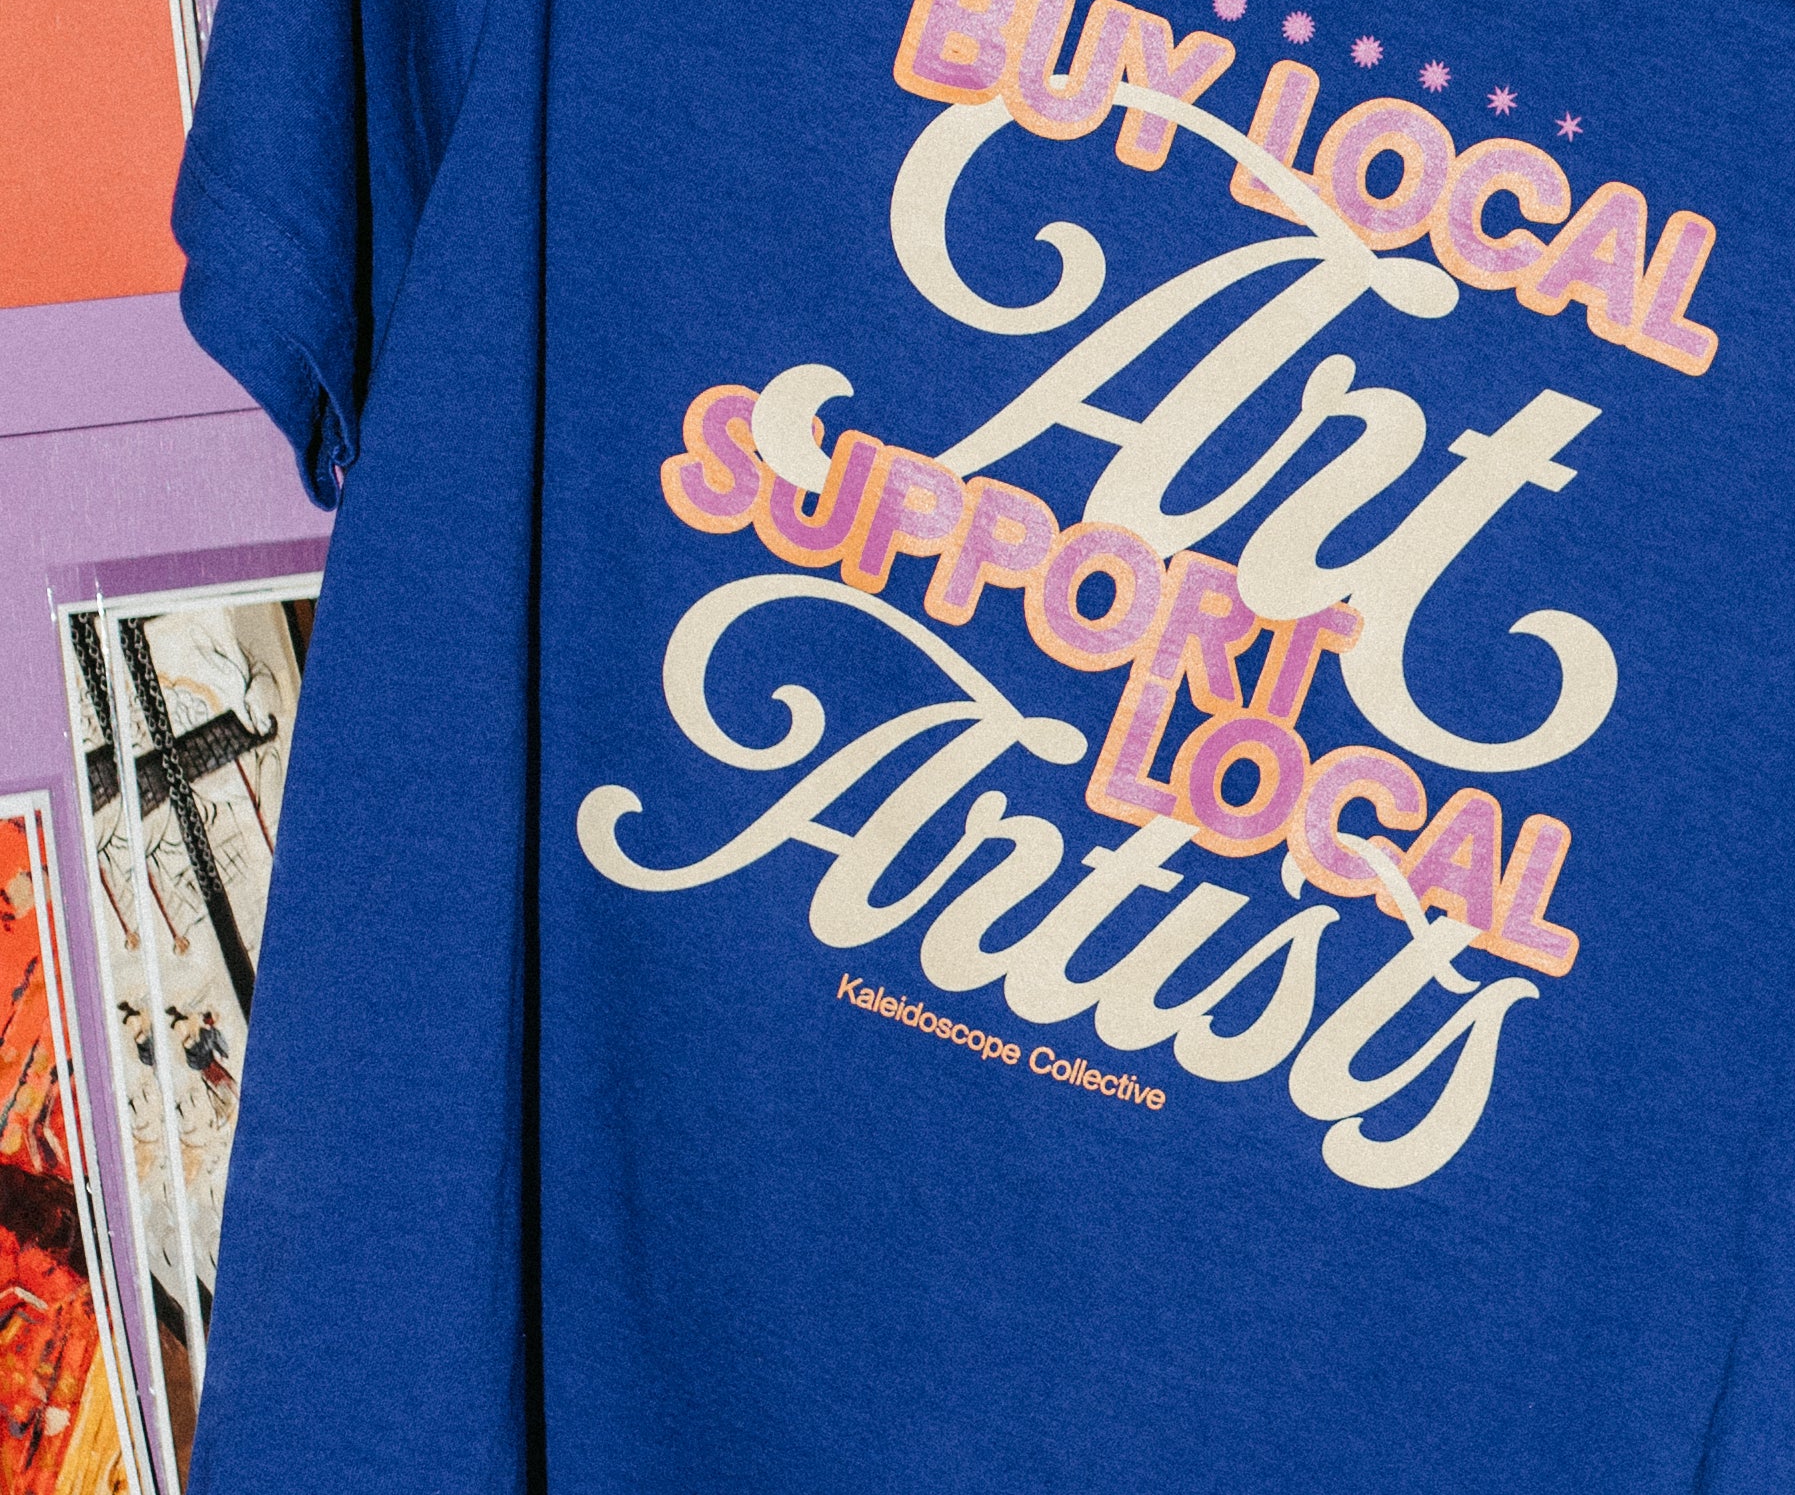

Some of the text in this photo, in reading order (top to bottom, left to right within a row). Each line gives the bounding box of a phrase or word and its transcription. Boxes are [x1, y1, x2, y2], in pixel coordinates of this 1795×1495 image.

[1230, 58, 1720, 378] LOCAL
[660, 383, 1364, 729] SUPPORT
[753, 72, 1618, 774] Art
[575, 572, 1541, 1189] Artists
[1085, 659, 1580, 978] LOCAL
[836, 972, 1168, 1112] Kaleidoscope Collective
